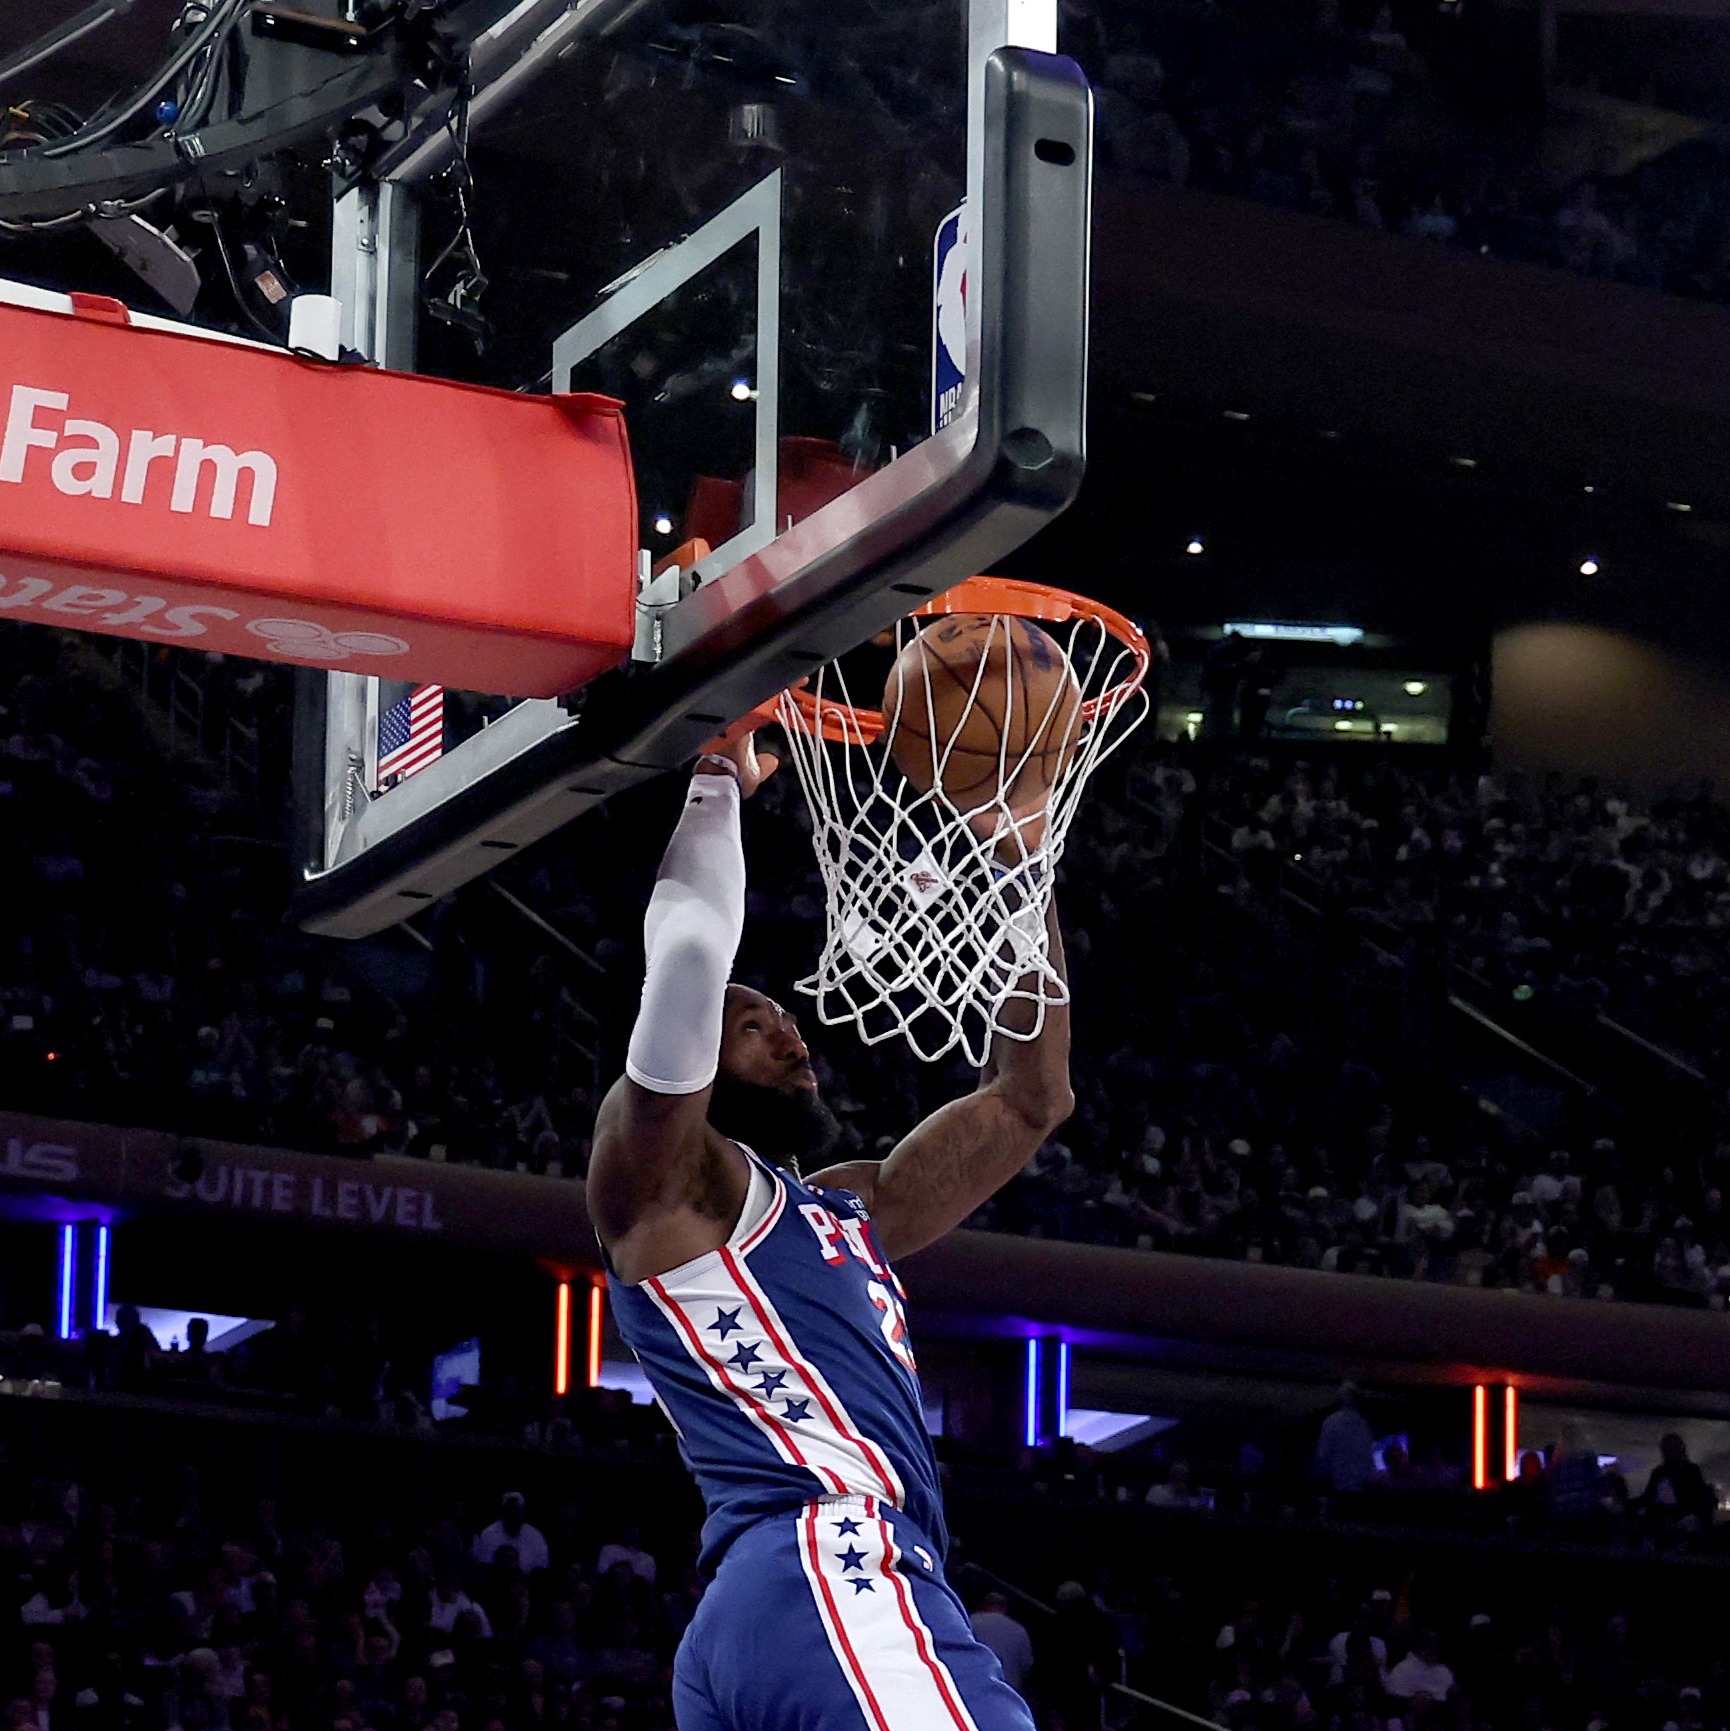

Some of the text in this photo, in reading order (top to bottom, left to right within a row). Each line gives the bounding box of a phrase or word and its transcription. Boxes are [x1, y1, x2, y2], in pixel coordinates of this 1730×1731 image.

[0, 384, 278, 527] Farm
[310, 1177, 442, 1229] LEVEL
[867, 1279, 917, 1373] 2
